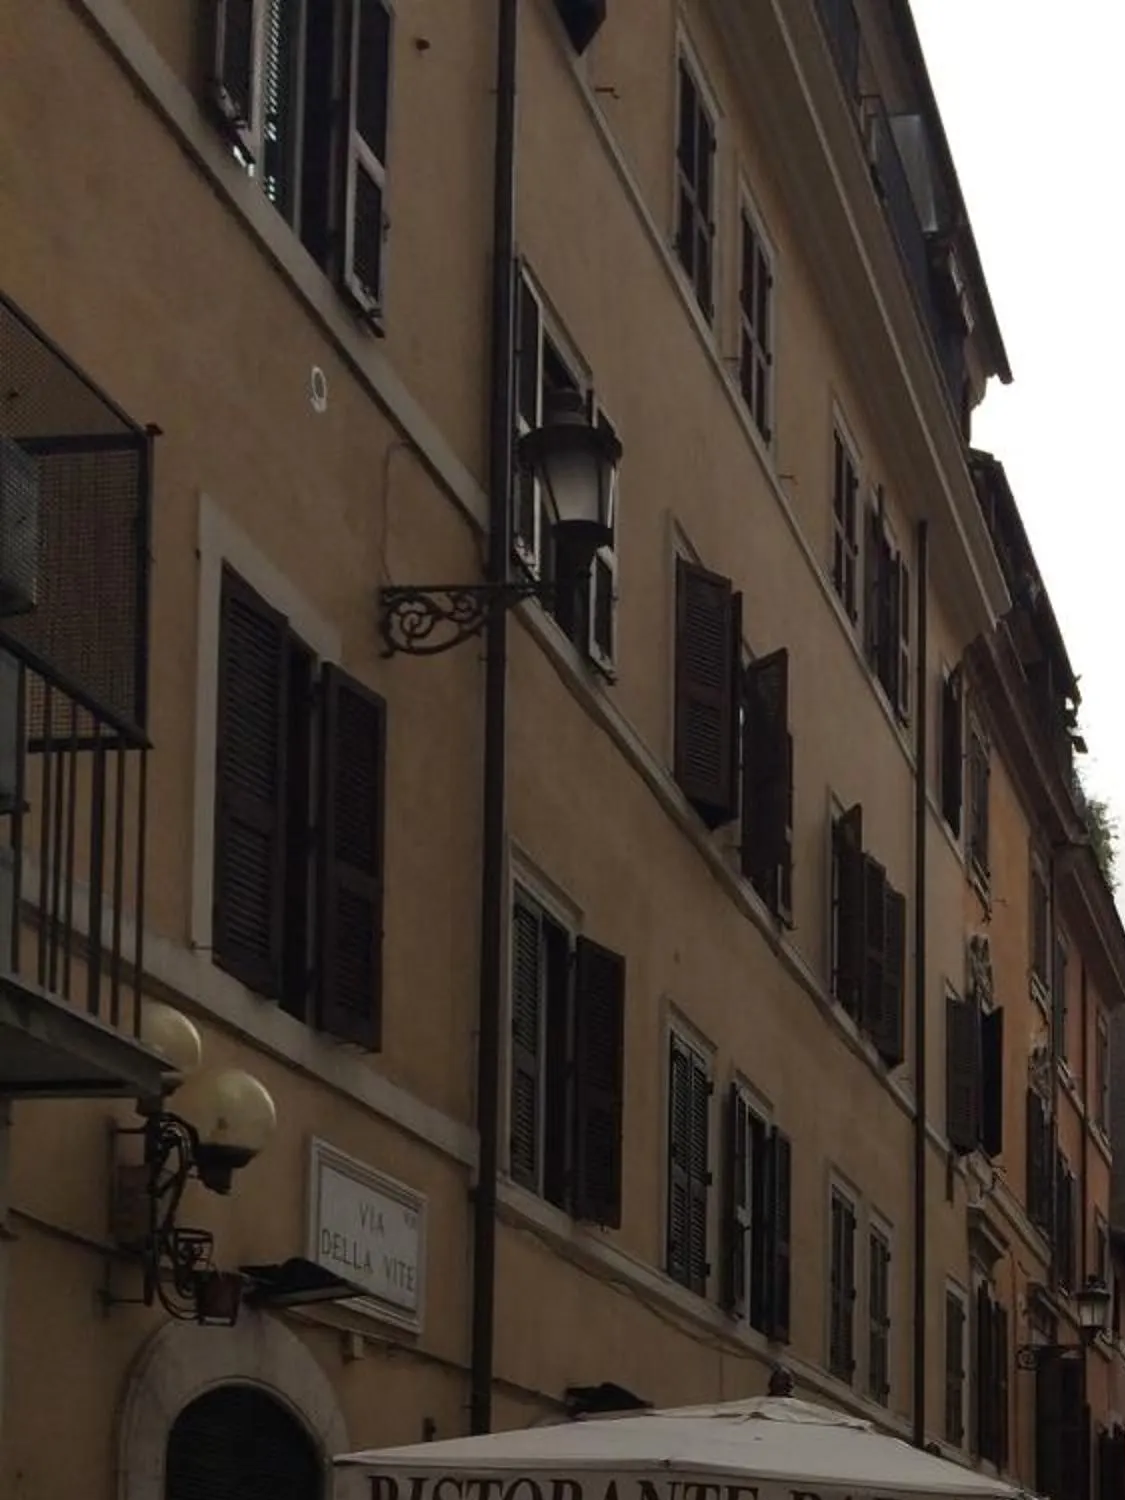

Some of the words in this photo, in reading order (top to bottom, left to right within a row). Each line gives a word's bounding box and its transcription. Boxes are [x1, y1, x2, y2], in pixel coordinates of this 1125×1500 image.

[359, 1204, 385, 1234] VIA
[321, 1228, 373, 1273] DELLA
[384, 1255, 416, 1292] VITE
